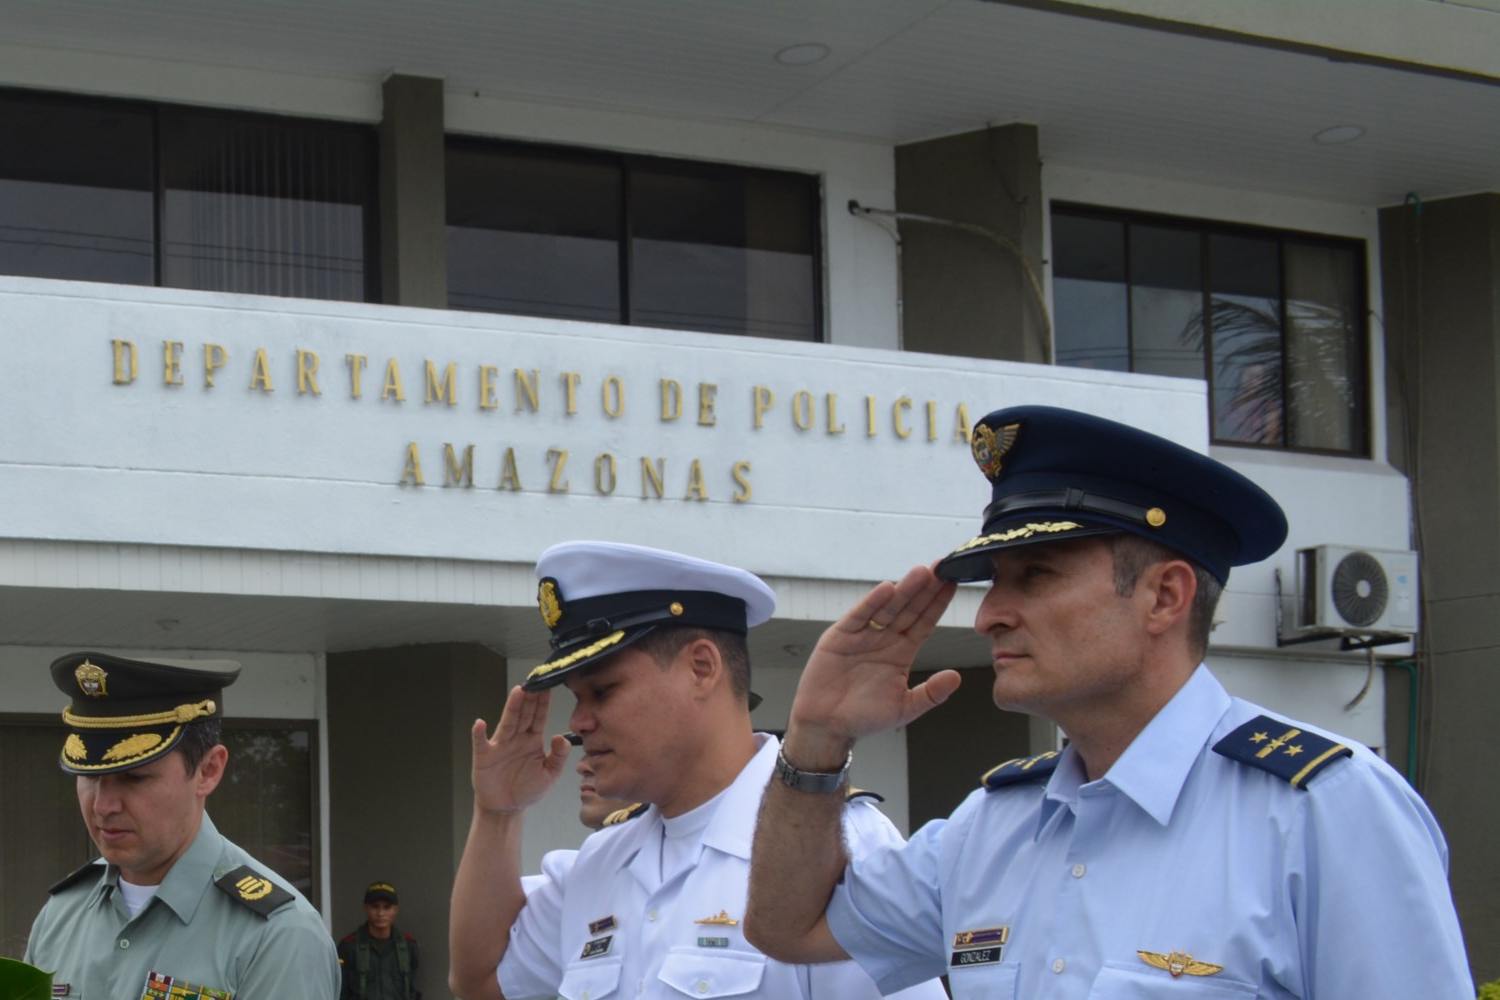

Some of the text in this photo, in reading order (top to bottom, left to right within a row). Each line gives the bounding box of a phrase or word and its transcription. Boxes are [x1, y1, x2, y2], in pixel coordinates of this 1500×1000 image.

[110, 338, 973, 444] DEPARTAMENTO DE POLICIA
[398, 440, 752, 503] AMAZONAS
